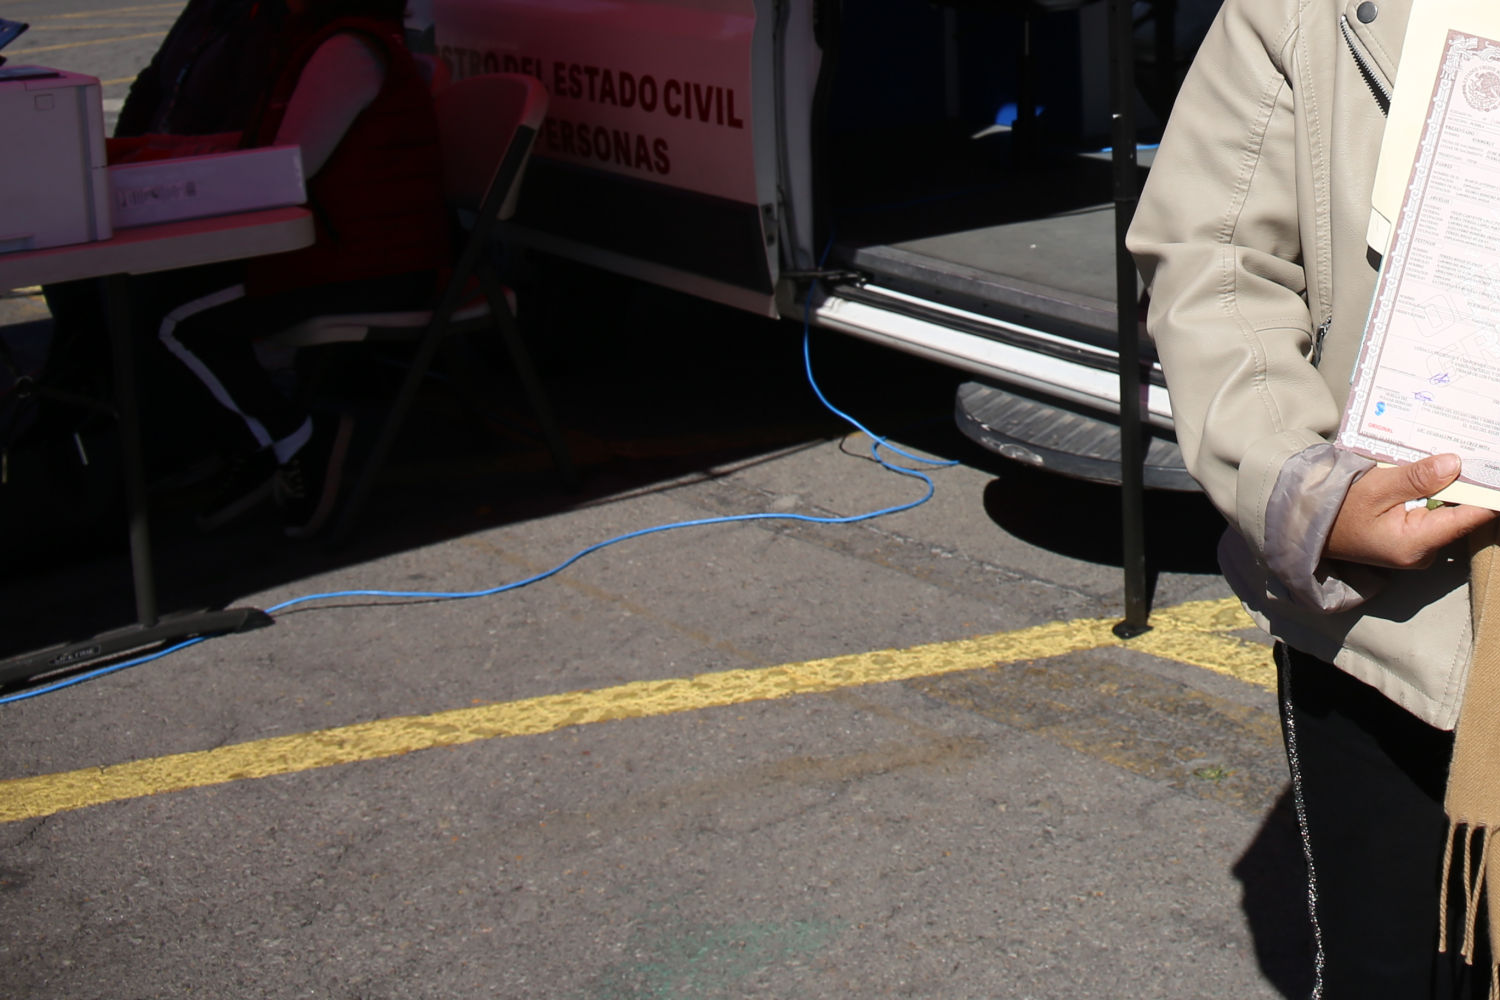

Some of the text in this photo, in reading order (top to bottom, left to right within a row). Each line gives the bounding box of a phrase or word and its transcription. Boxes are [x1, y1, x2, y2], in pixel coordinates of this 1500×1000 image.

[554, 62, 658, 114] ESTADO
[663, 78, 744, 130] CIVIL
[538, 116, 671, 176] ERSONAS
